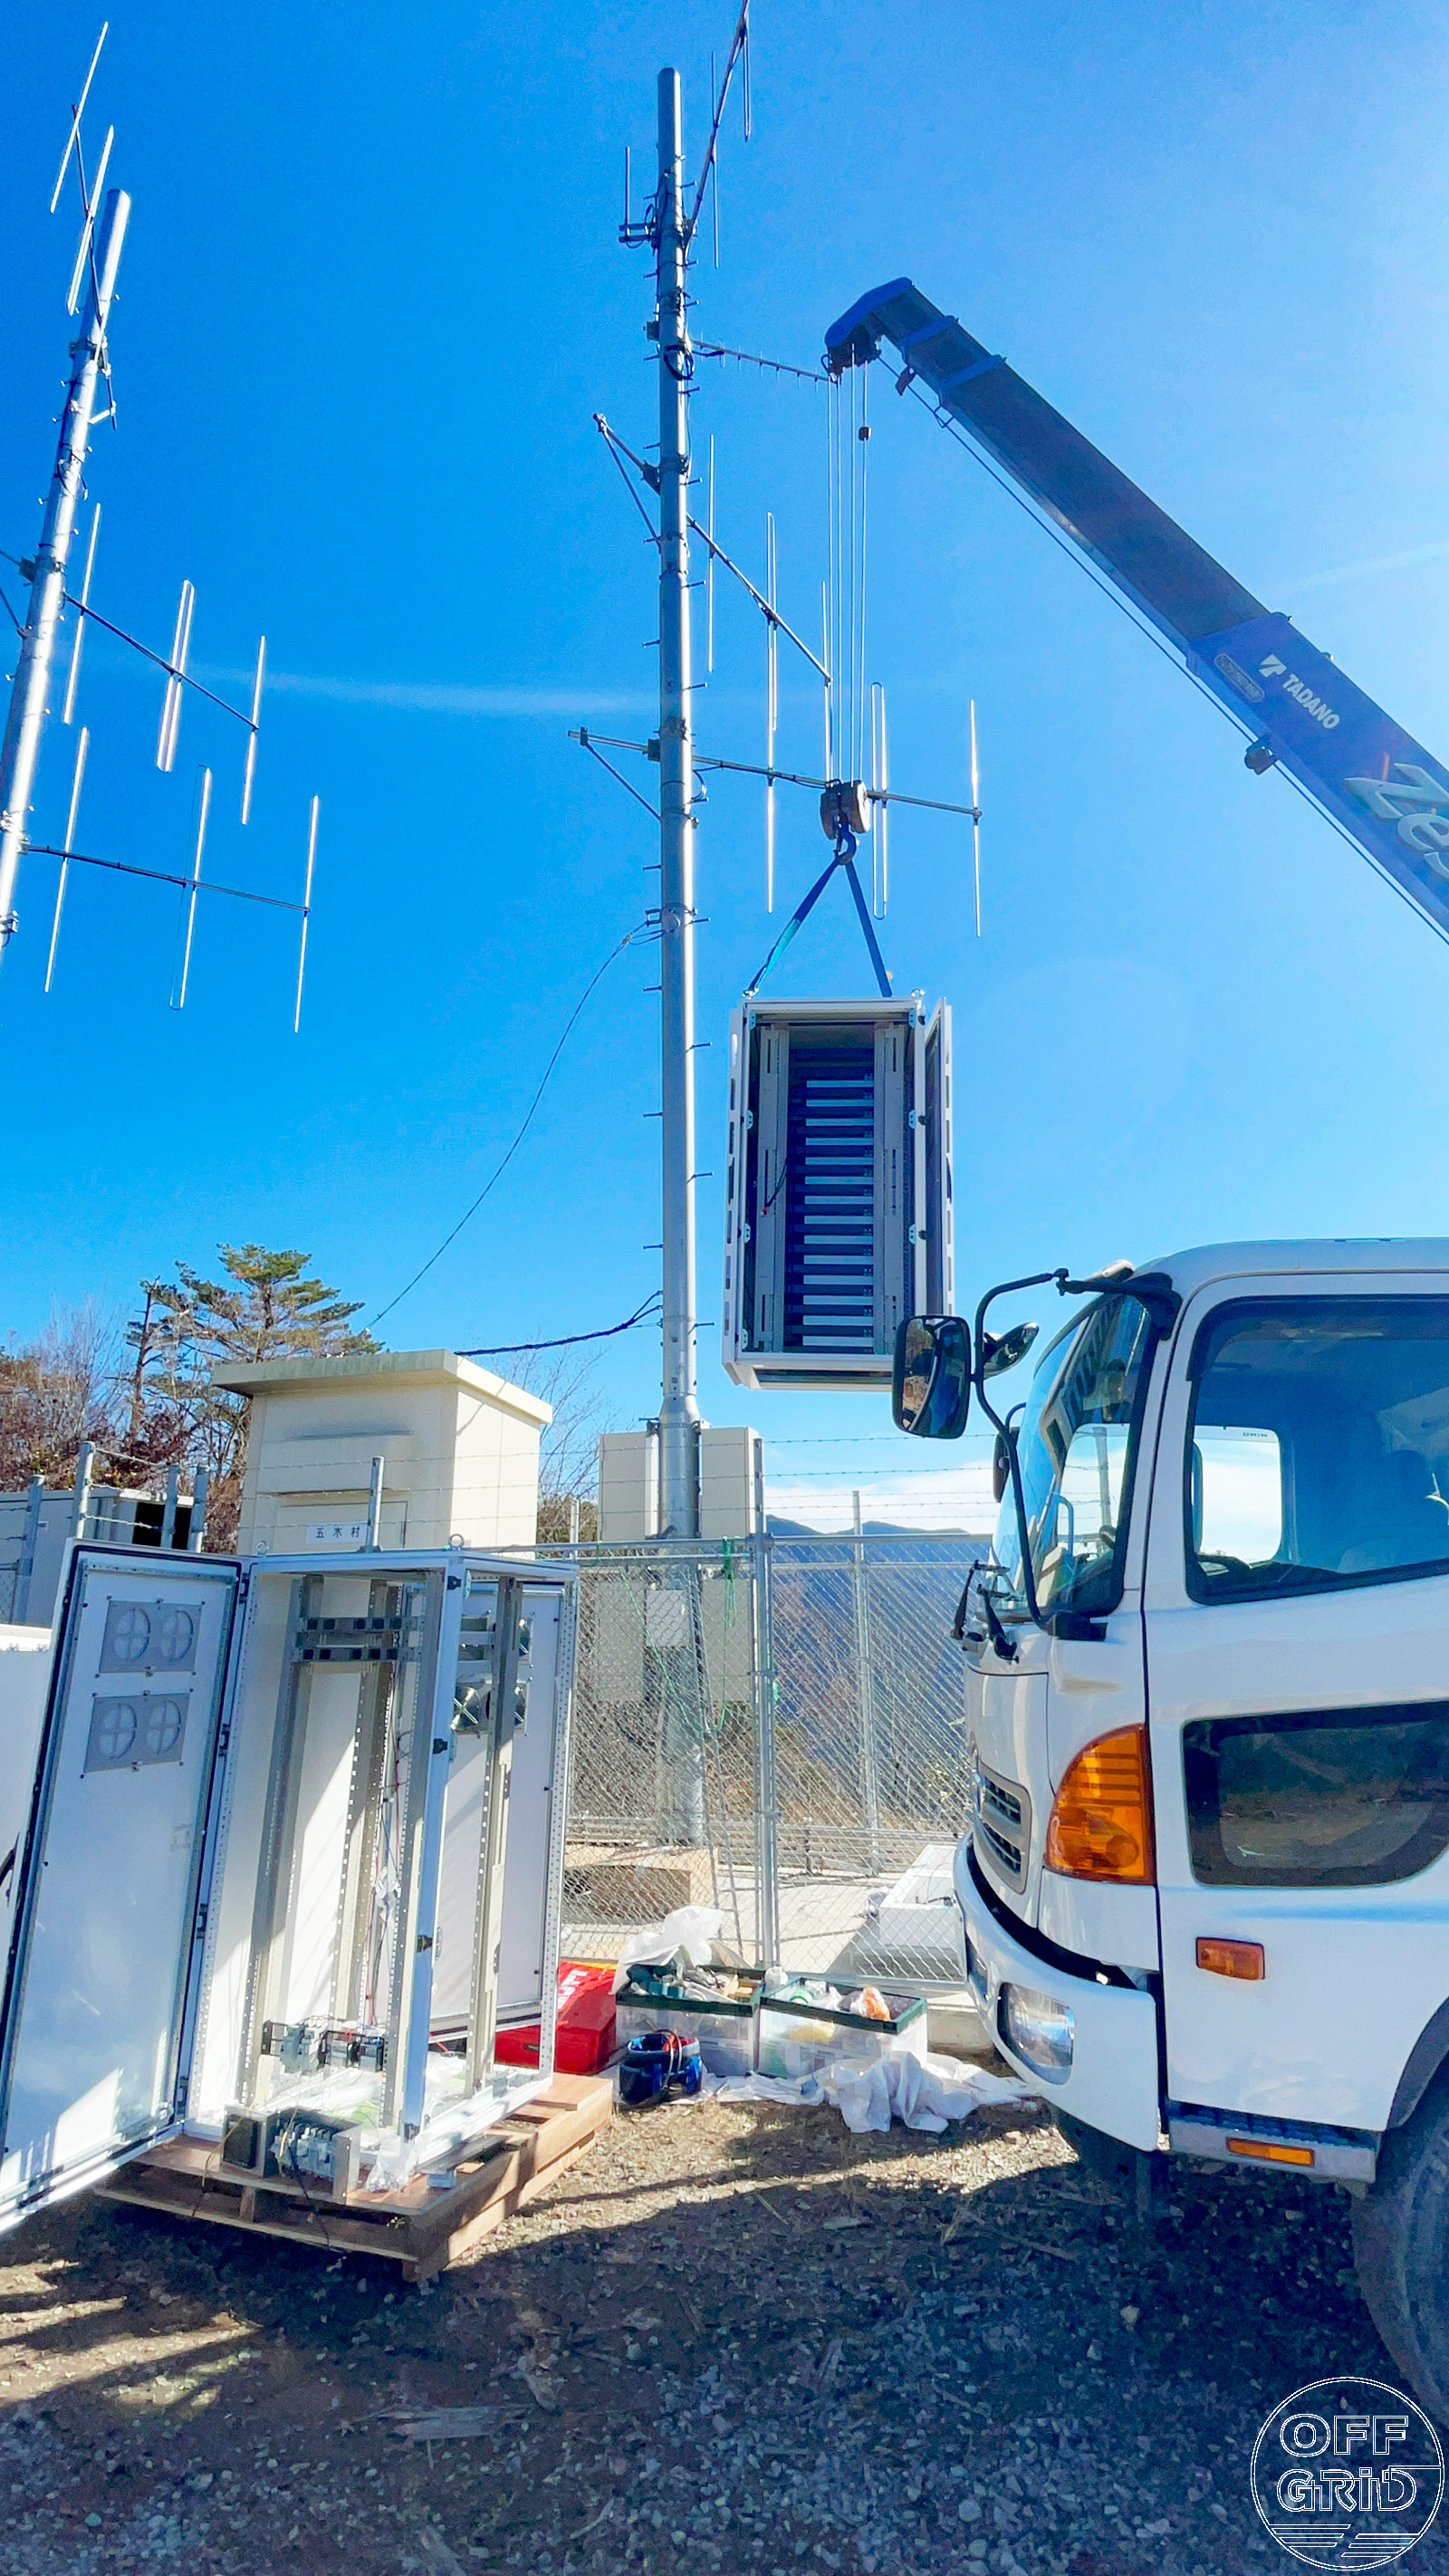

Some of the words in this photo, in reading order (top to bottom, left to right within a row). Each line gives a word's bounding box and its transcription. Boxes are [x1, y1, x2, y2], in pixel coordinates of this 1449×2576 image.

[1282, 673, 1340, 729] TADANO
[316, 1525, 360, 1539] 五木村
